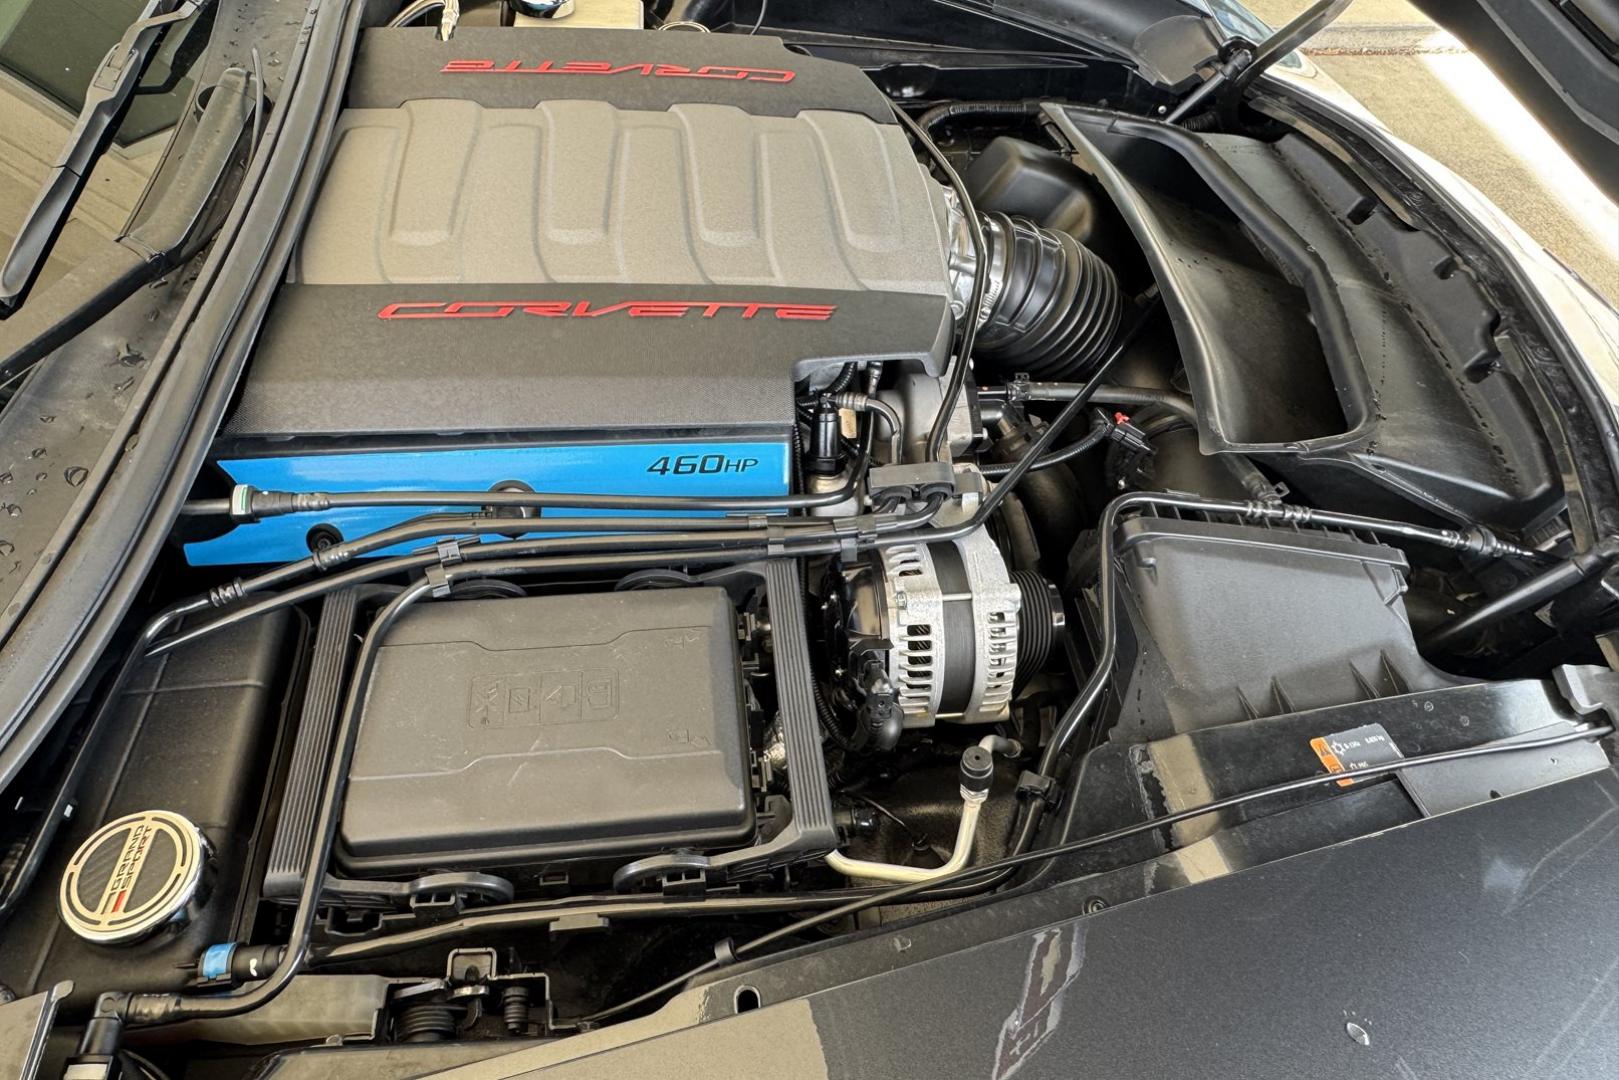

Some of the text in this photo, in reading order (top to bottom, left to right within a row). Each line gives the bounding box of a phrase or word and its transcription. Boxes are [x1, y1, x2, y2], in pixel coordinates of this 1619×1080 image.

[440, 60, 796, 83] CORVETTE
[377, 301, 838, 321] CORVETTE
[111, 825, 144, 891] GRAND
[121, 825, 152, 889] SPORT
